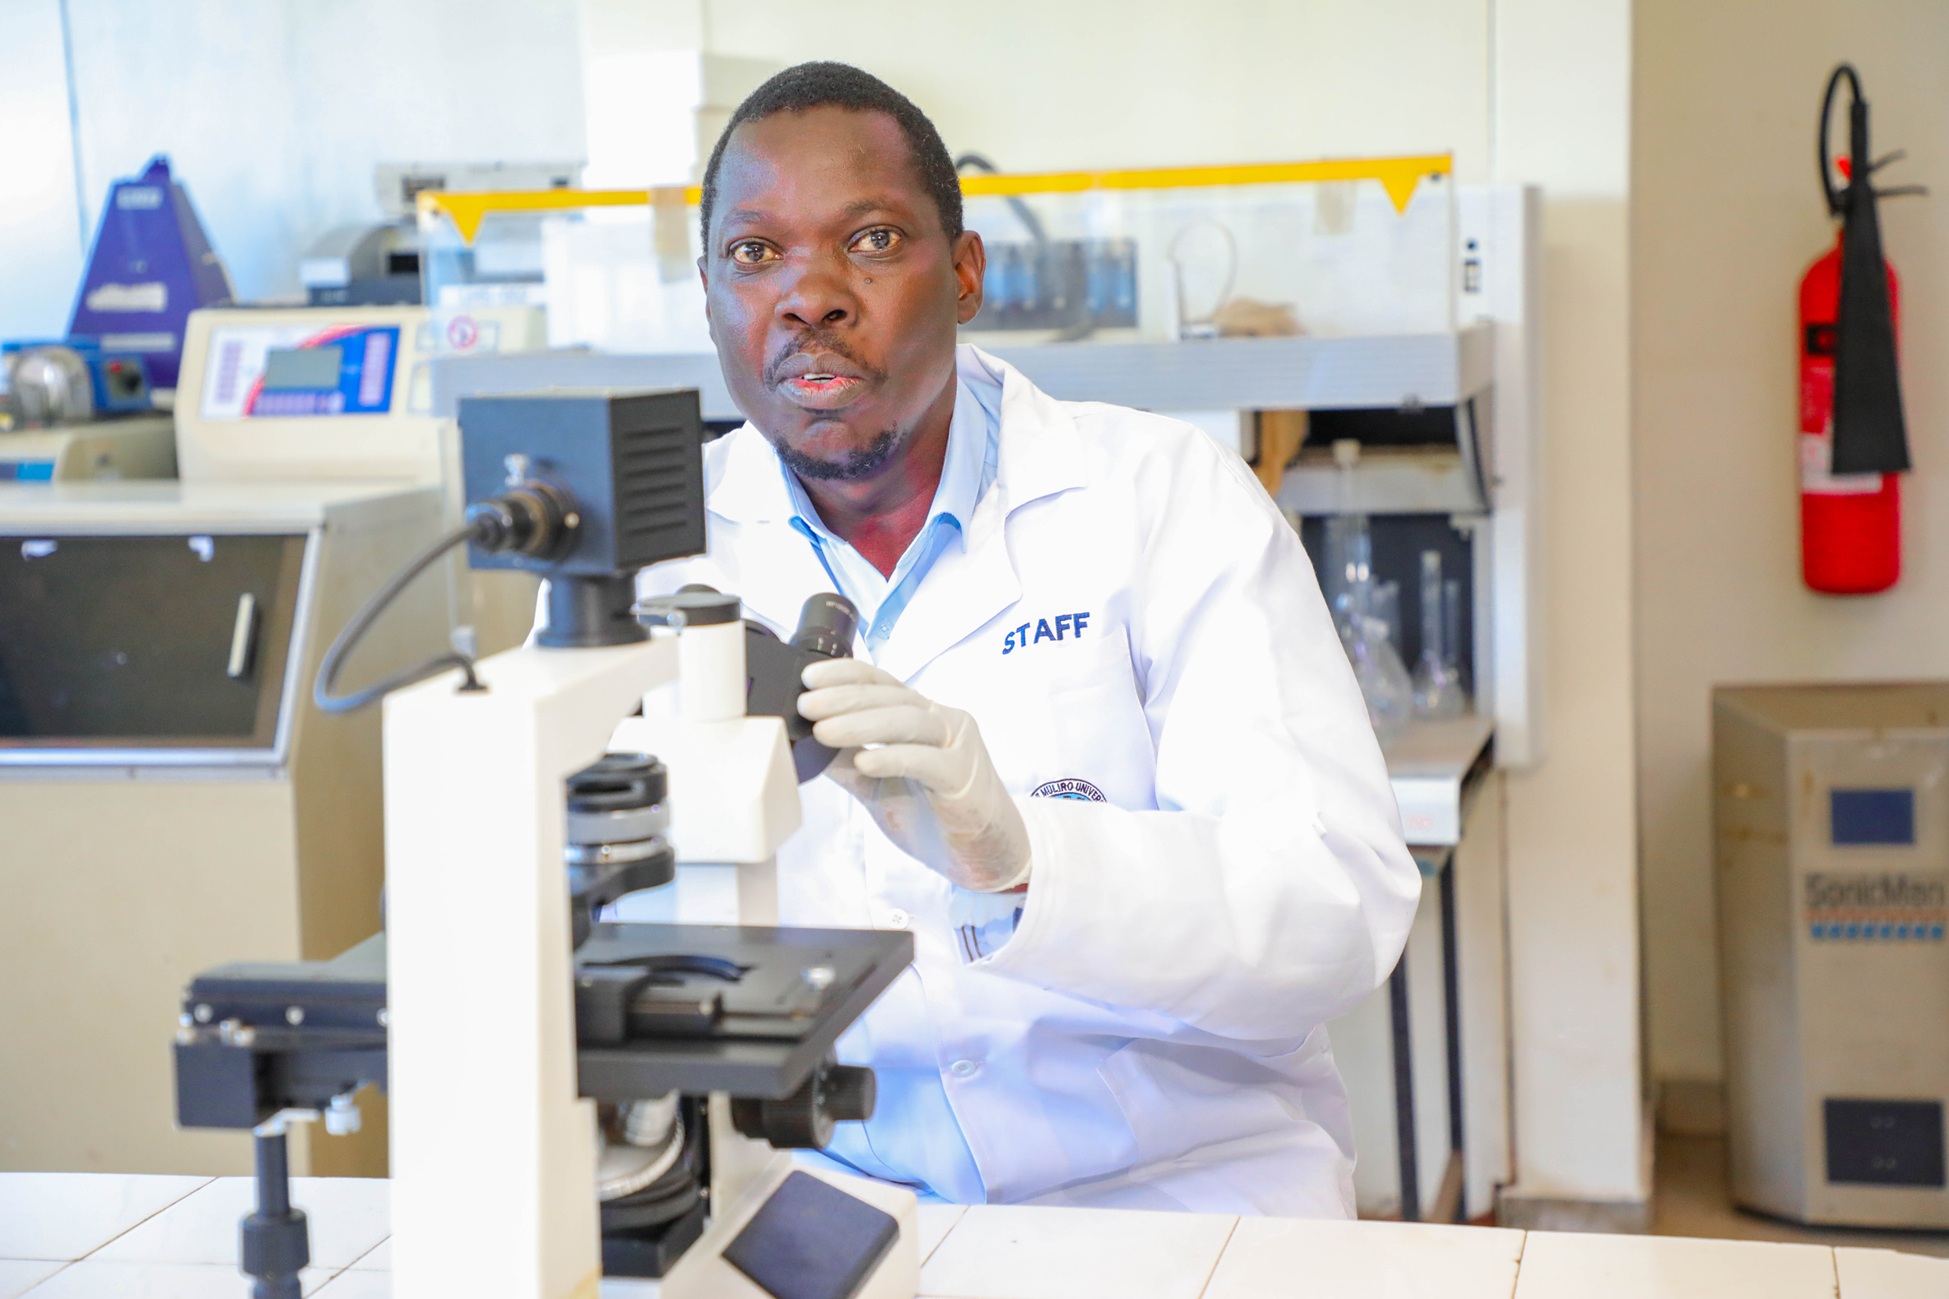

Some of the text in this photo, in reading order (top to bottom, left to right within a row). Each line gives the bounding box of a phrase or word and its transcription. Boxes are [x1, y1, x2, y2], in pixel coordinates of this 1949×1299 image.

[1002, 612, 1090, 655] STAFF
[1040, 781, 1104, 802] MULIRO UNIVER
